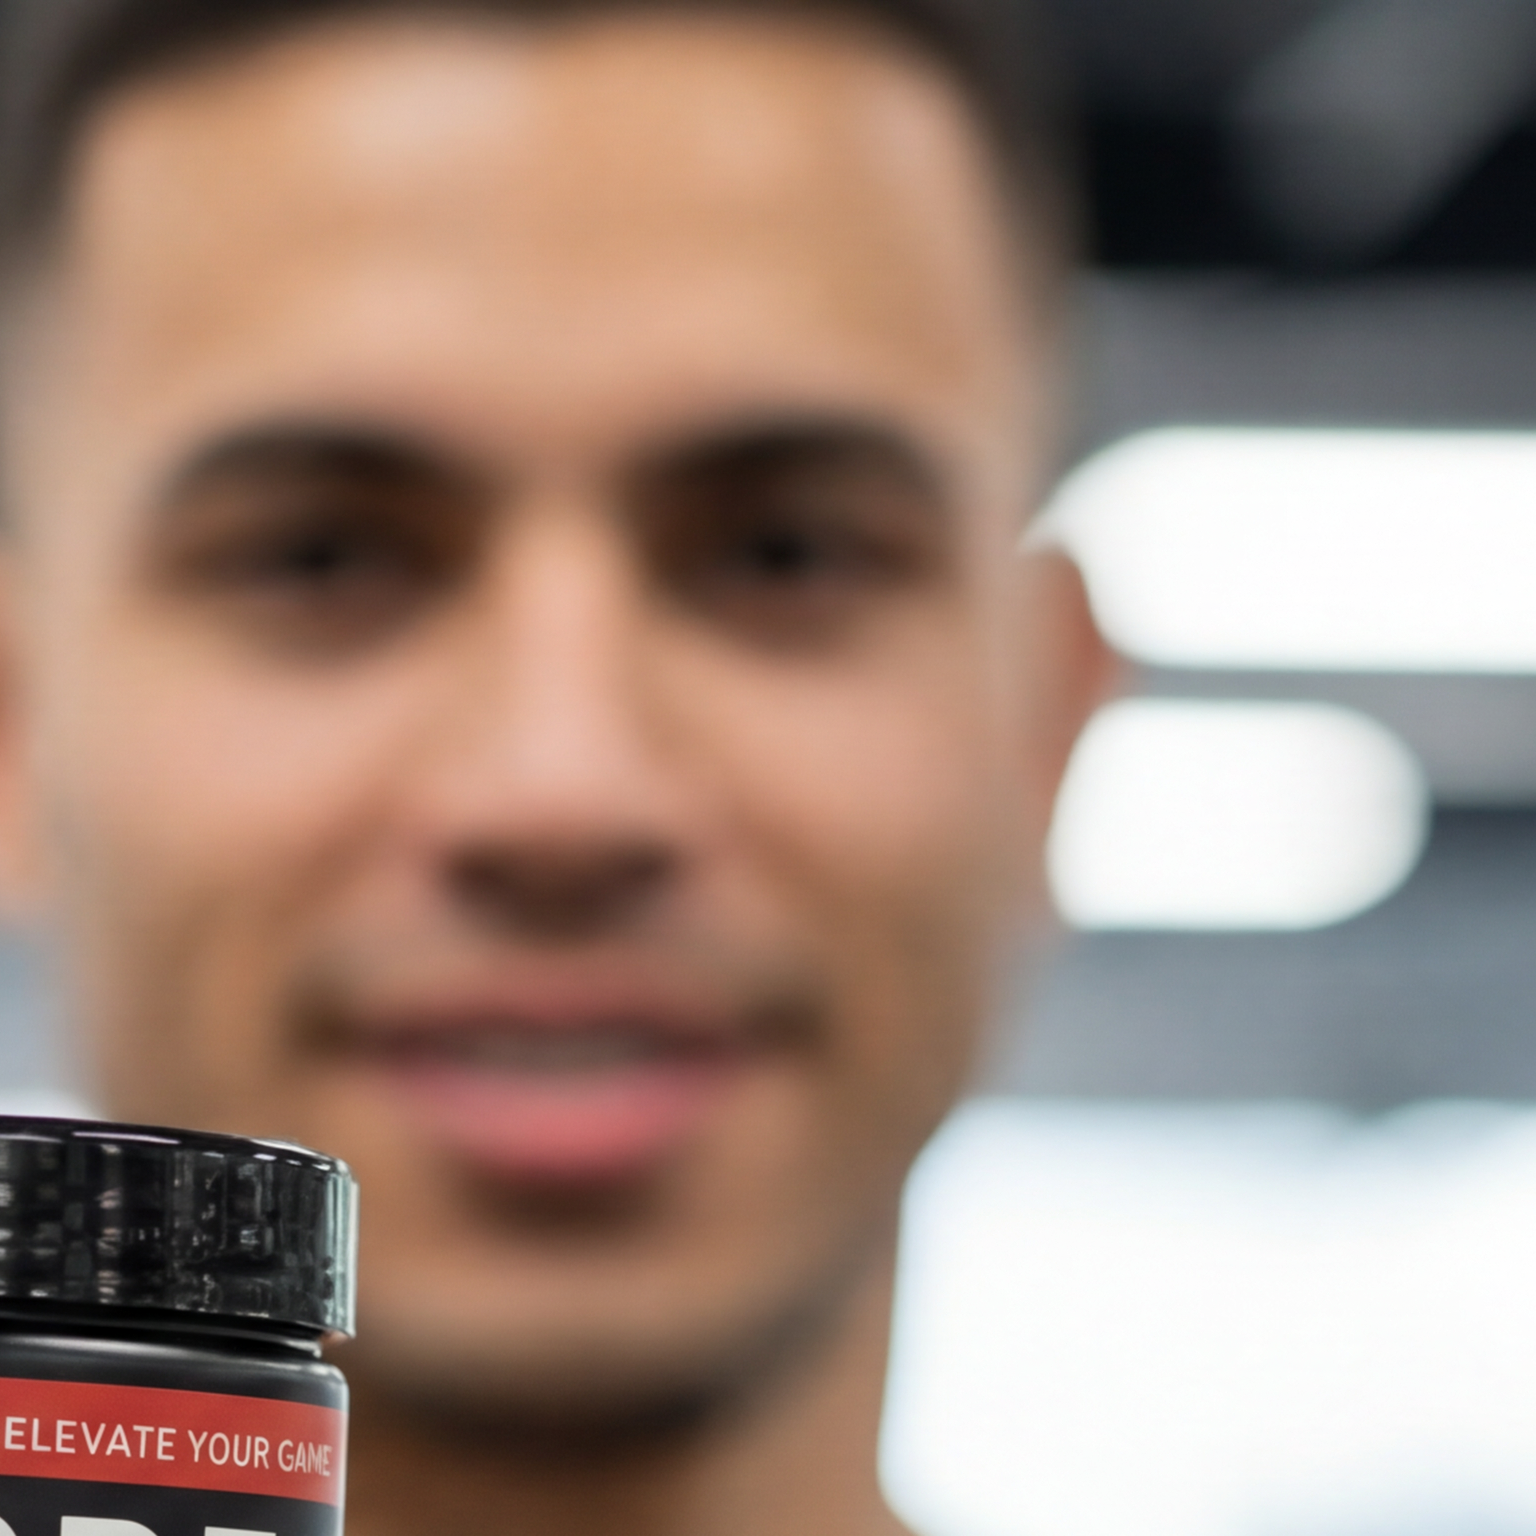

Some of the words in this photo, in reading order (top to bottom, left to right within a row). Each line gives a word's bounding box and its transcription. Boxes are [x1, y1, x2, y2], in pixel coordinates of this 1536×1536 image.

[4, 1415, 176, 1461] ELEVATE
[187, 1429, 270, 1470] YOUR
[277, 1439, 332, 1477] GAME
